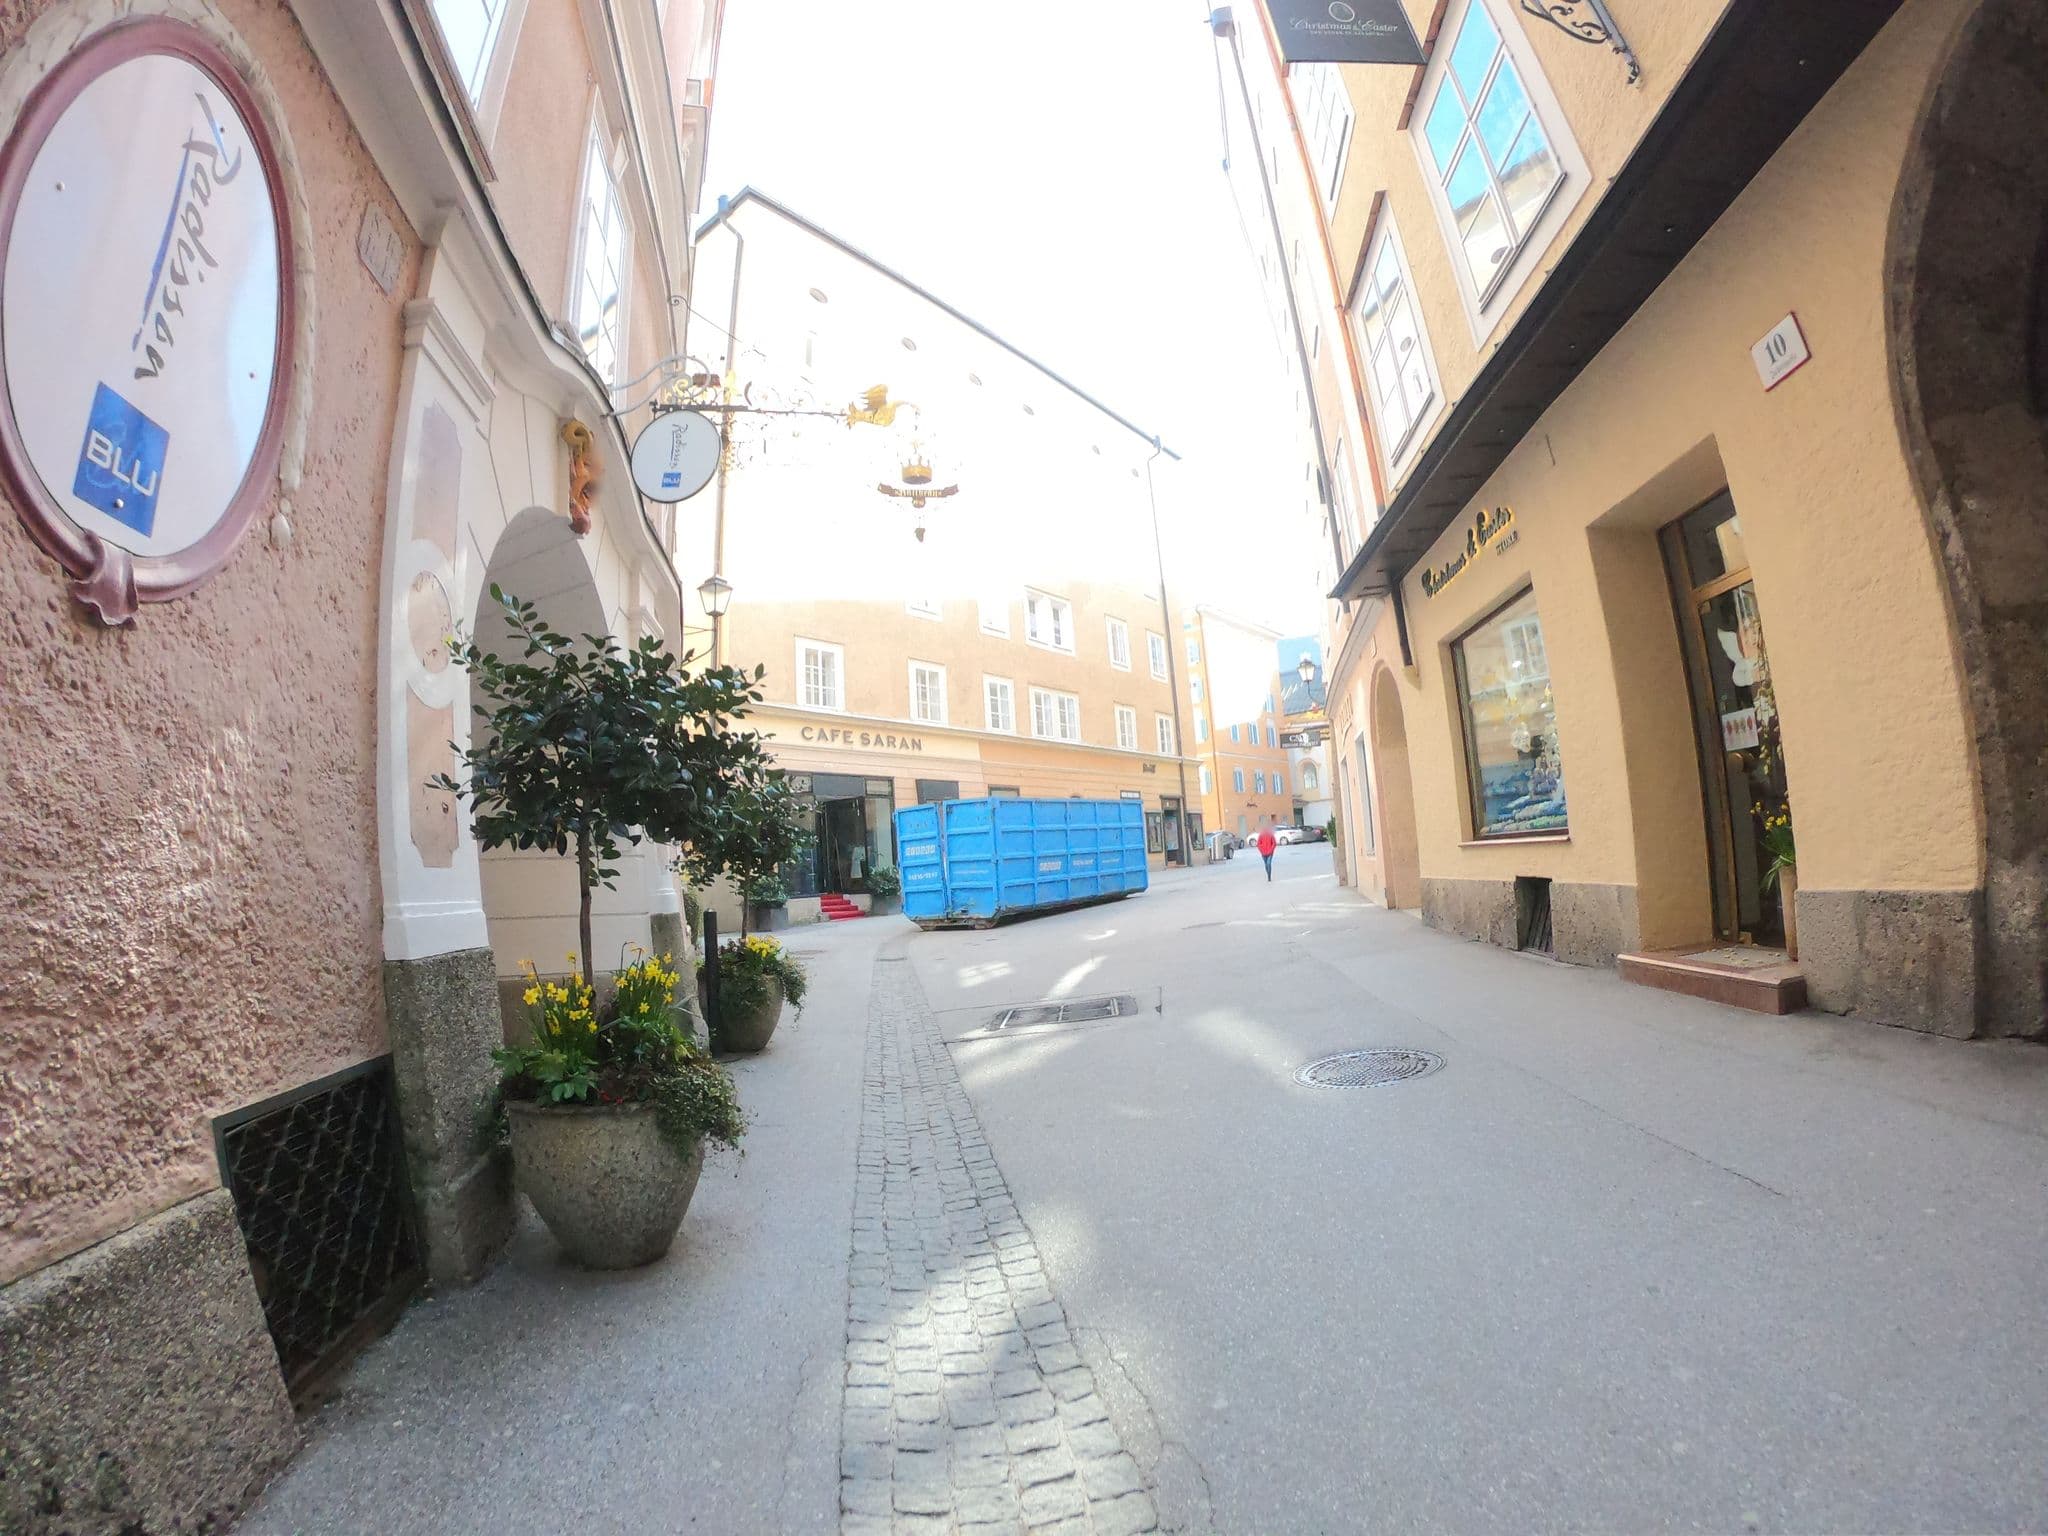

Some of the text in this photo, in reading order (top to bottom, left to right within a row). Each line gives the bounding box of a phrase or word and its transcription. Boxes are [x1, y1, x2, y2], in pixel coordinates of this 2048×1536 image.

[1358, 19, 1398, 32] Easter
[132, 92, 242, 381] Radisson
[1765, 333, 1786, 364] 10
[86, 429, 159, 497] BLU
[801, 726, 923, 751] CAFE SARAN
